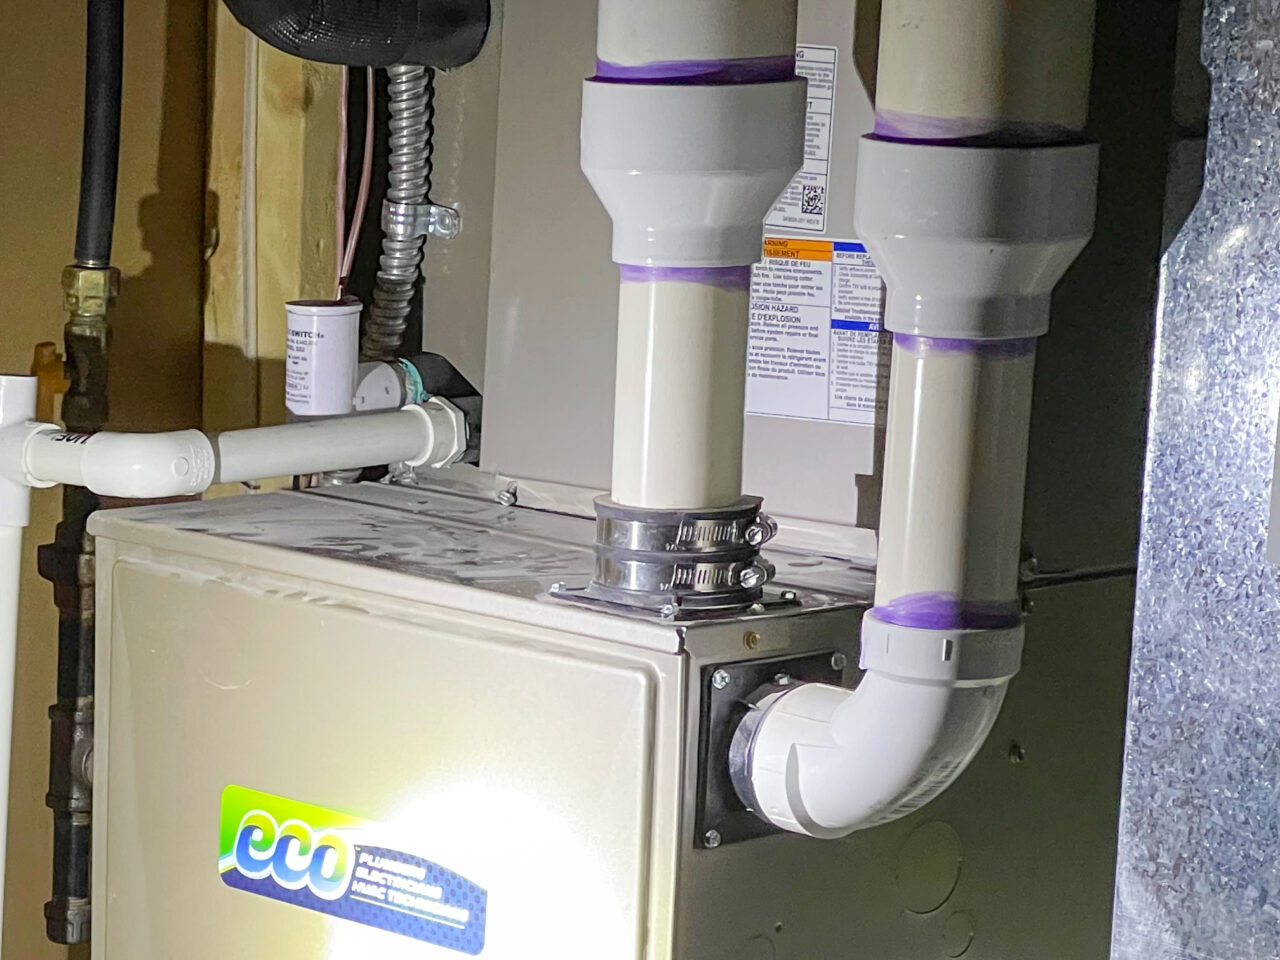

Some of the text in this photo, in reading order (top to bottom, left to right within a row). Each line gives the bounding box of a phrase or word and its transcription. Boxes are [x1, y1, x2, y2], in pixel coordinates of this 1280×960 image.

[772, 304, 798, 313] HAZARD
[758, 313, 801, 323] D'EXPLOSION
[234, 811, 352, 896] eco
